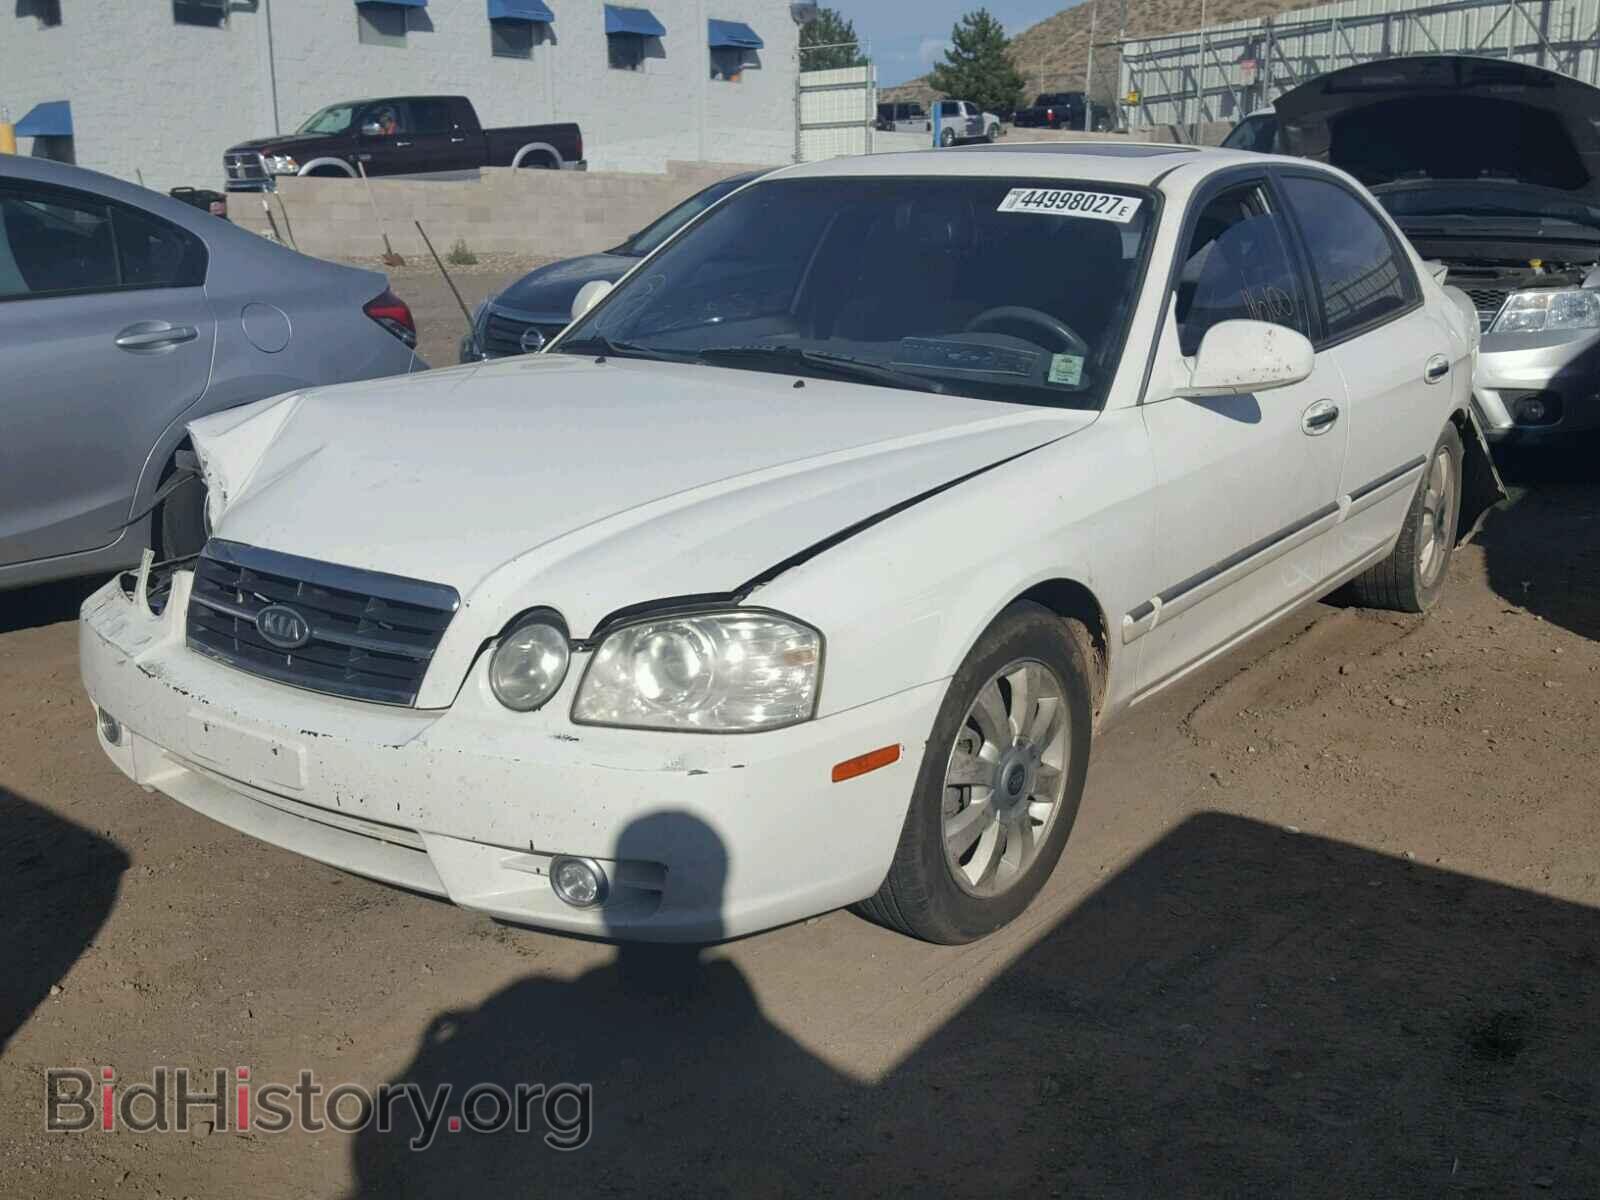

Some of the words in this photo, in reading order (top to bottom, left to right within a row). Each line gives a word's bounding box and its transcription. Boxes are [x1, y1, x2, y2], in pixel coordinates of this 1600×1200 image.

[1020, 190, 1124, 214] 44998027
[1118, 206, 1129, 217] E
[264, 612, 299, 640] KIA
